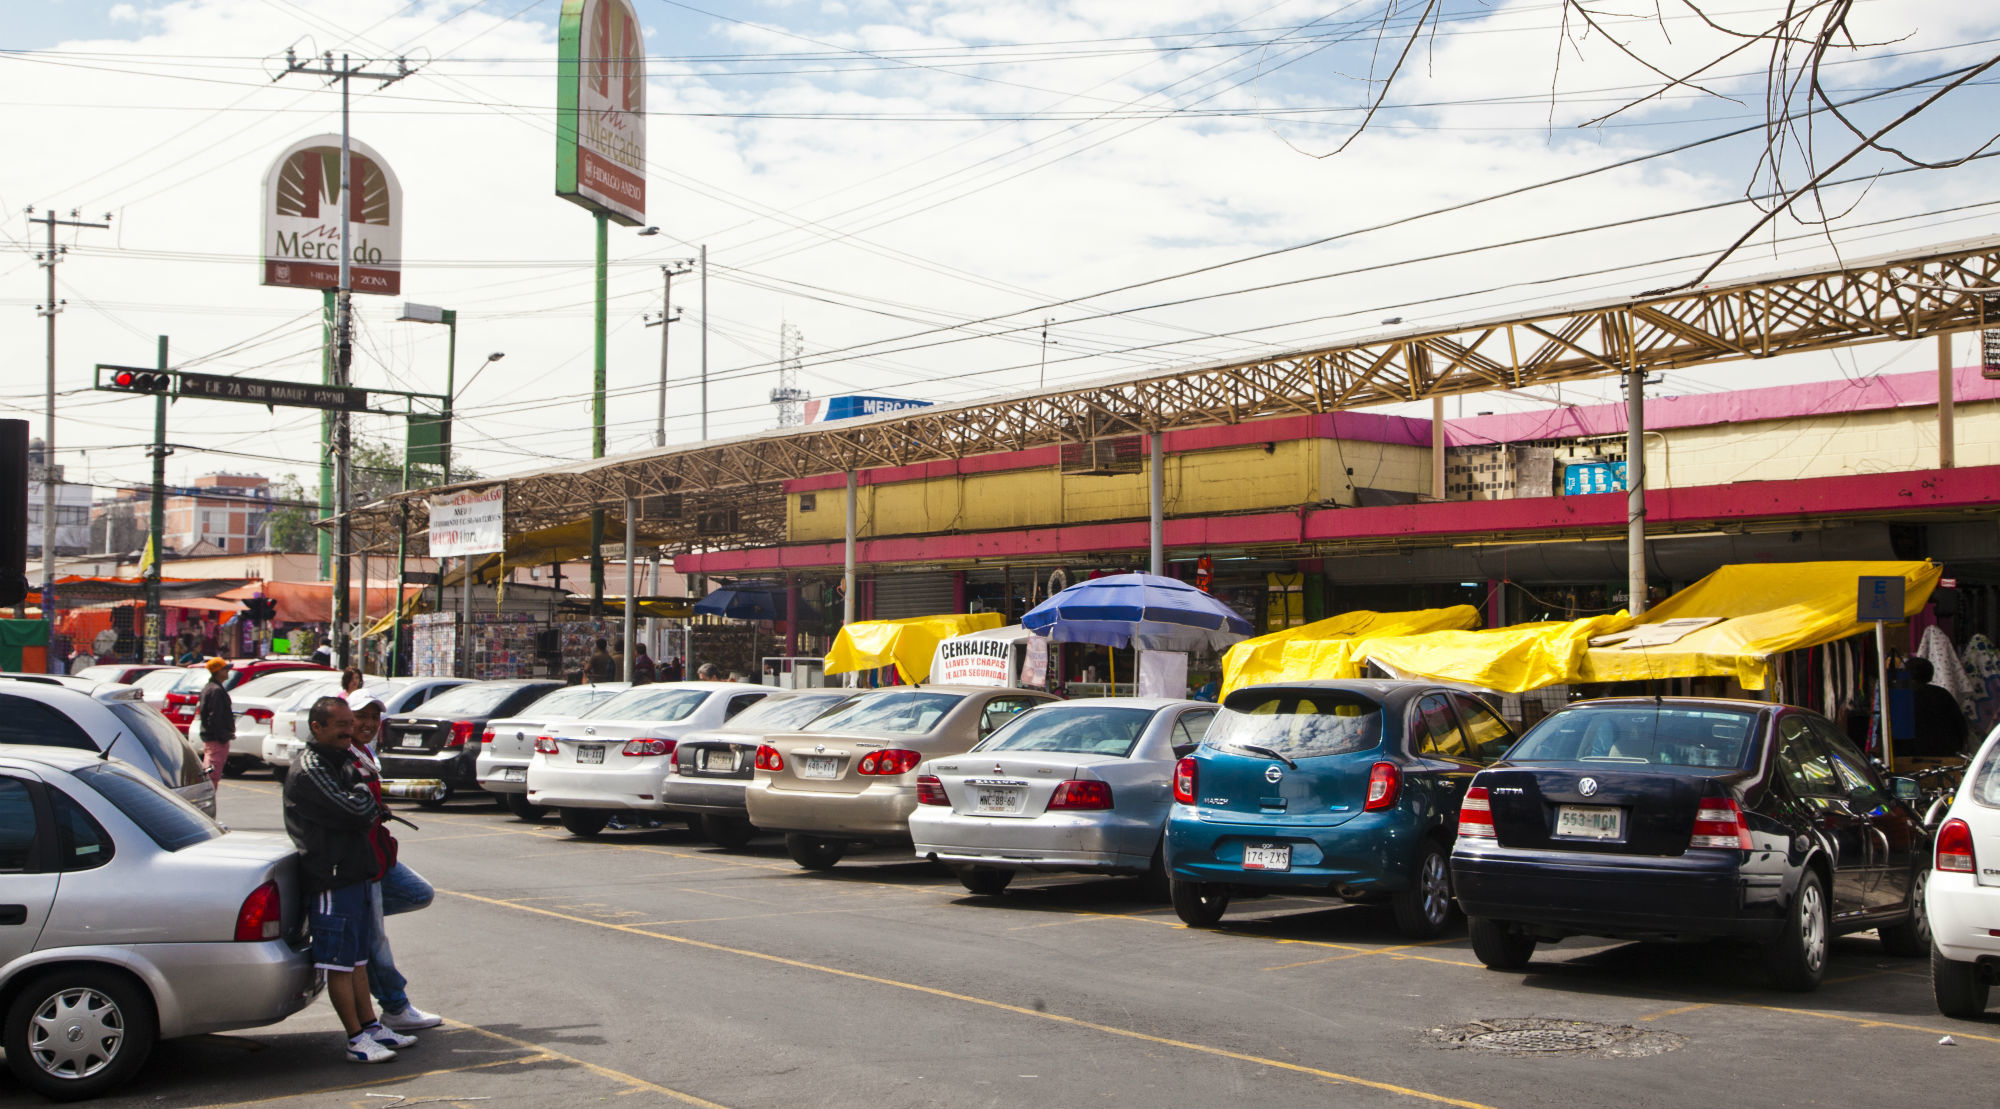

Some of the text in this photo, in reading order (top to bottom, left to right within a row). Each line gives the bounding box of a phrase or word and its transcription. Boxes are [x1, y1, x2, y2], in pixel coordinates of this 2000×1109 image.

[585, 105, 641, 170] Mercado
[592, 165, 621, 191] HIDALGO
[275, 230, 383, 264] Mercdo
[360, 275, 388, 287] ZONA
[247, 386, 266, 398] SUR
[1875, 580, 1887, 595] E
[941, 639, 1009, 660] CERRAJERIA
[945, 656, 1006, 670] LLAVES Y CHAPAS
[953, 669, 967, 679] ALTA
[1493, 787, 1523, 796] JETTA
[1204, 797, 1229, 805] MARCH
[1562, 812, 1617, 829] 553-NGN
[1247, 851, 1288, 864] 174-ZXS
